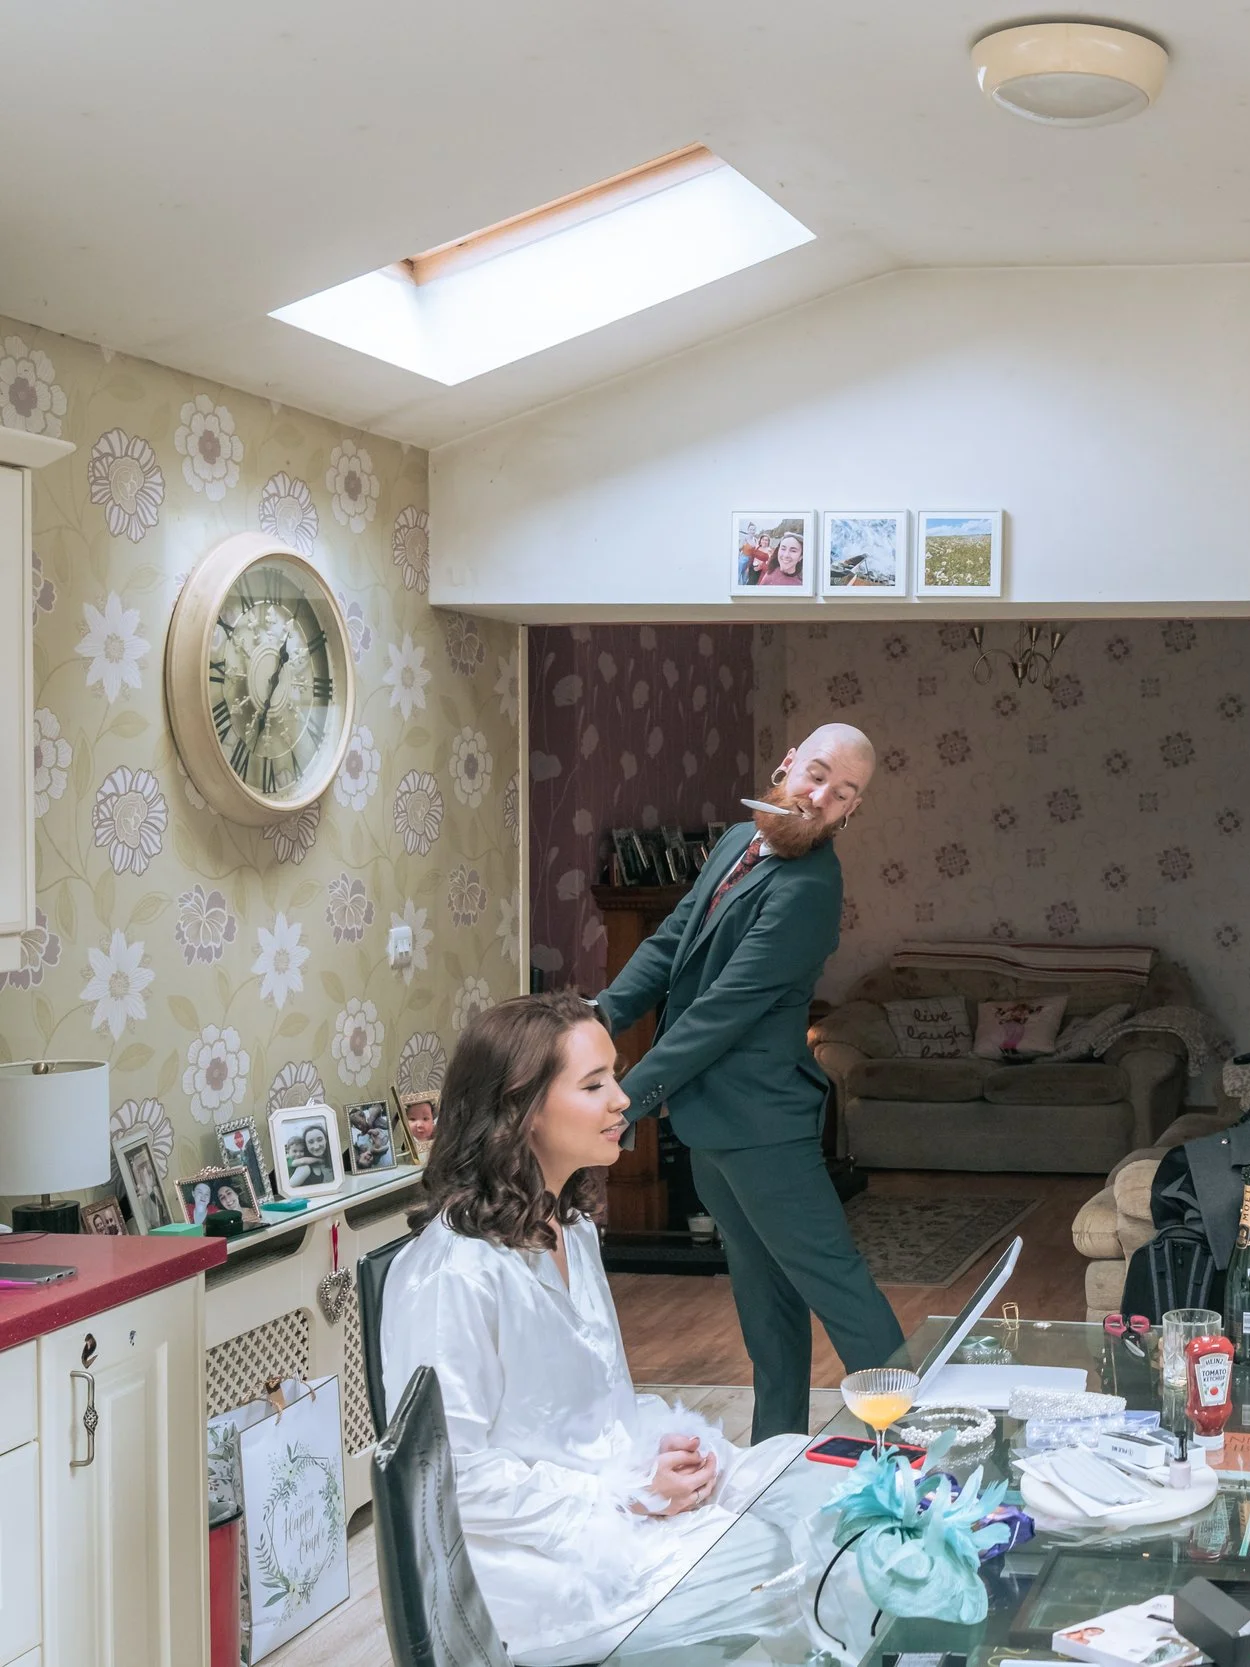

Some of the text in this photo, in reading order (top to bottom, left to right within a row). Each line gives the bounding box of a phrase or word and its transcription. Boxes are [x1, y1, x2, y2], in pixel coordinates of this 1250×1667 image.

[313, 677, 333, 700] III
[211, 698, 233, 745] VIII
[914, 1009, 952, 1022] live
[907, 1026, 969, 1045] laugh
[921, 1045, 963, 1059] love
[1205, 1358, 1224, 1366] HEINZ
[1202, 1369, 1227, 1377] TOMATO
